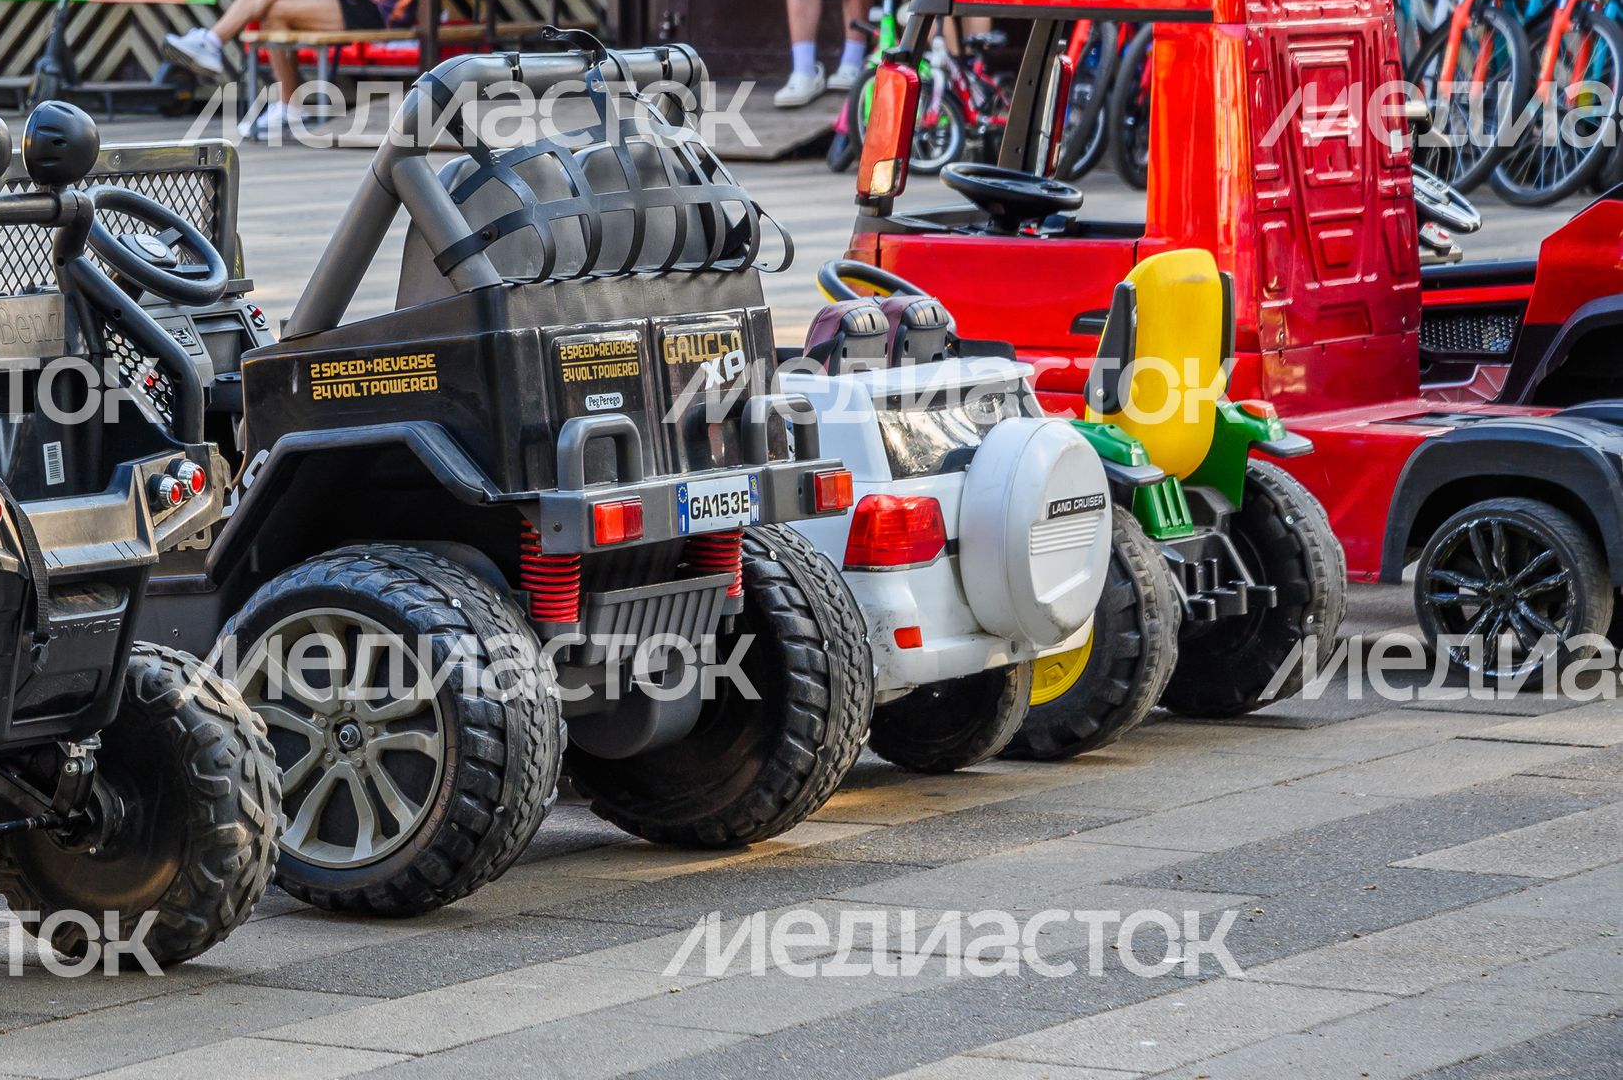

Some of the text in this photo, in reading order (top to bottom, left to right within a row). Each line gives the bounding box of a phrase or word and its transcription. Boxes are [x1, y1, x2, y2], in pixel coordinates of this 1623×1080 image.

[700, 349, 746, 390] XP
[690, 490, 750, 520] GA153E
[1052, 495, 1104, 515] LAND CRUISER
